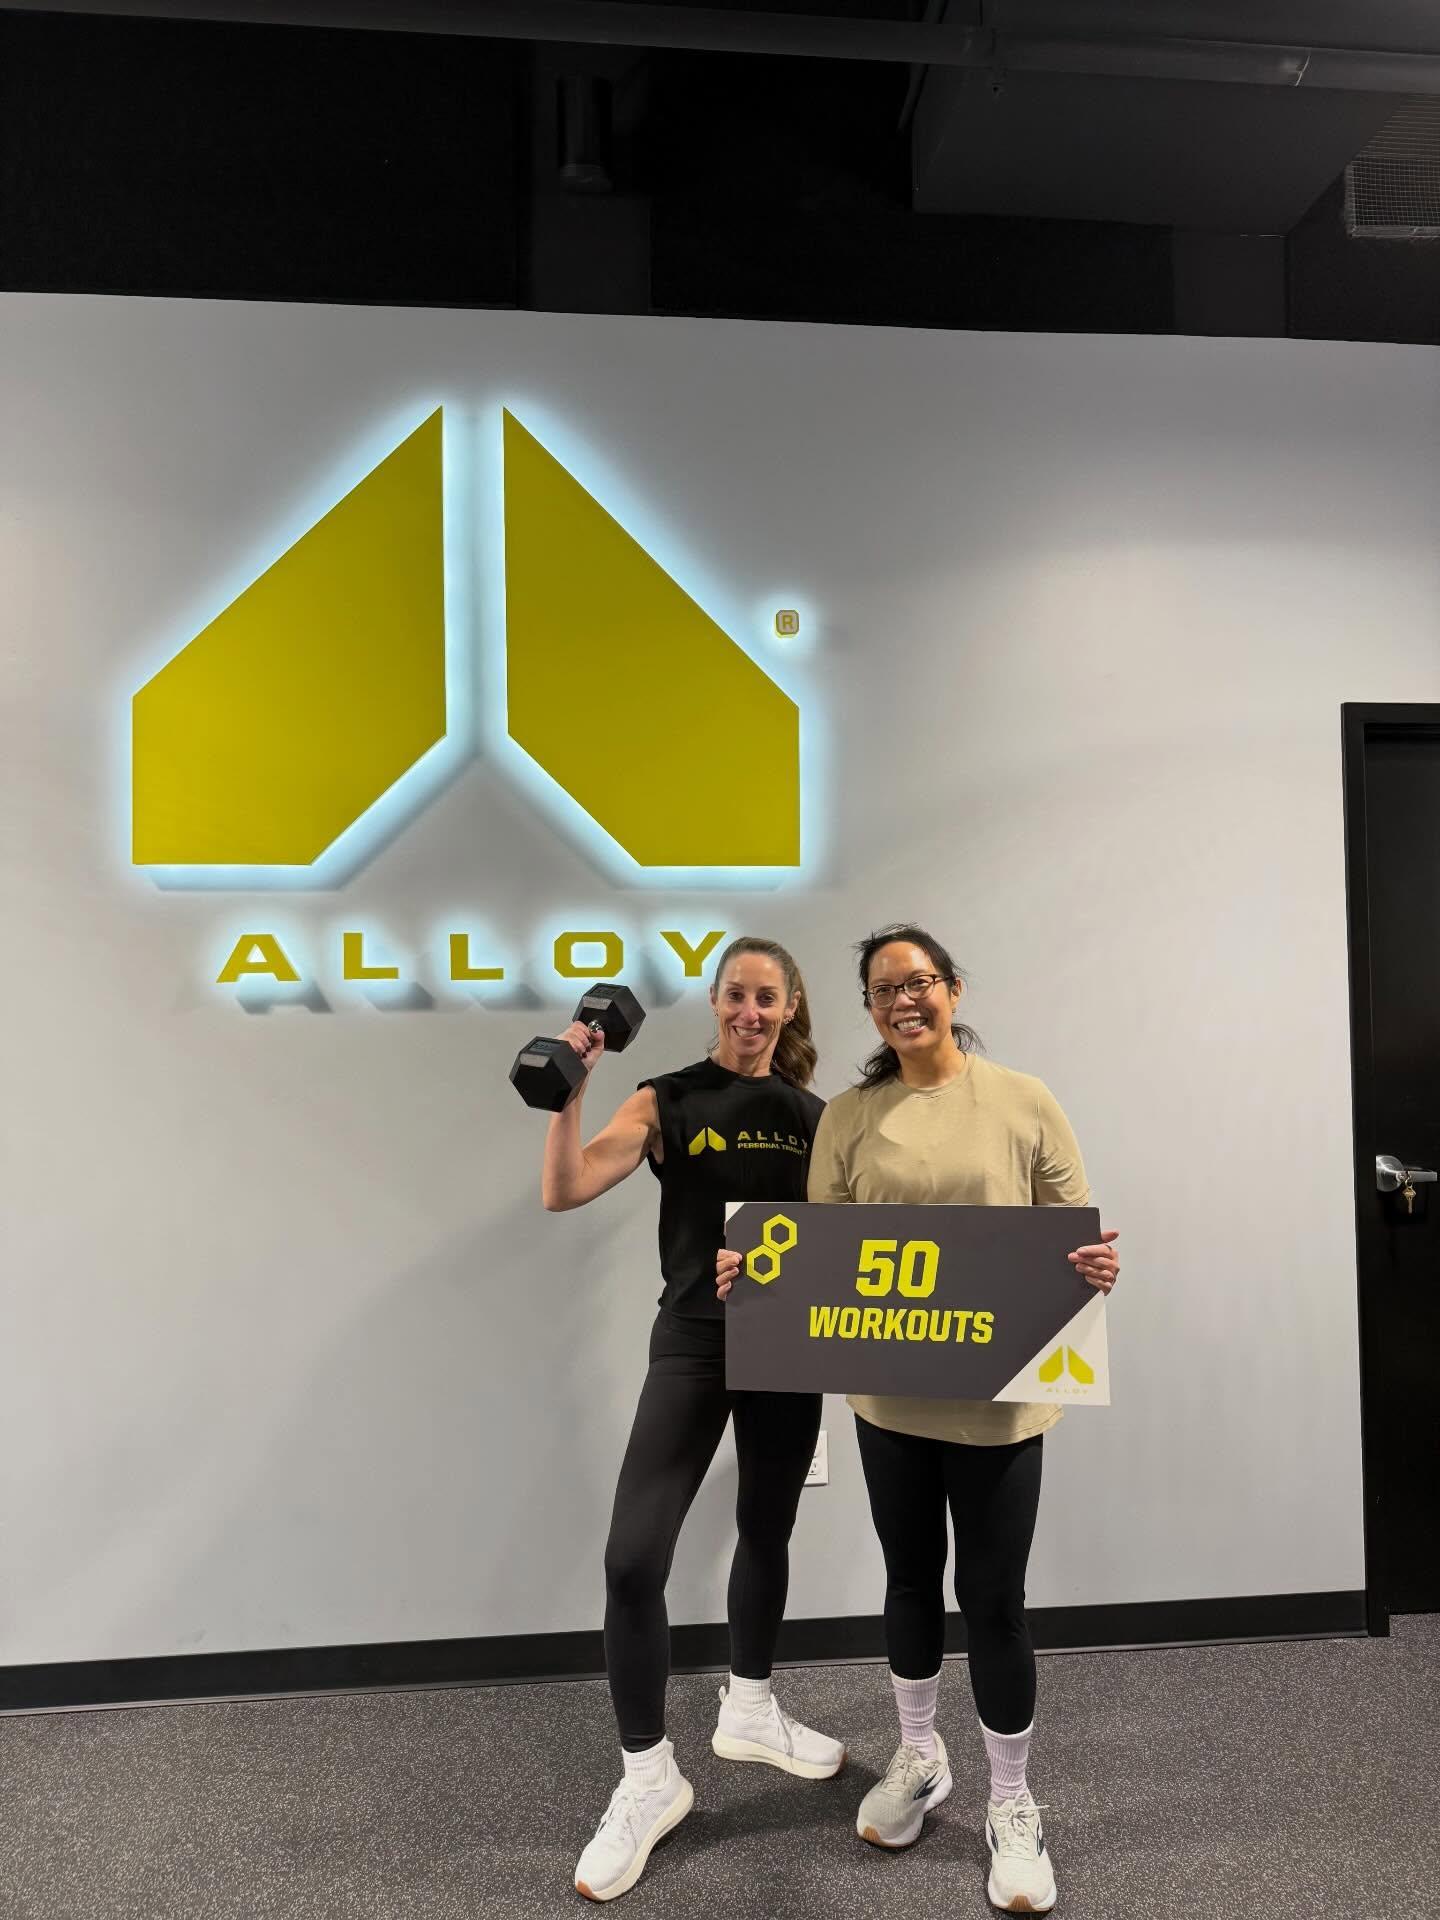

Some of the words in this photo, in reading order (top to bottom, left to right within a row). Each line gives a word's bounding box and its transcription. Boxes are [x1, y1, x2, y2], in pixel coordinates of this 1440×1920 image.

[216, 931, 727, 984] ALLOY
[737, 1130, 808, 1149] ALLOY
[737, 1142, 780, 1150] PERSONAL
[855, 1239, 940, 1298] 50
[809, 1306, 994, 1344] WORKOUTS
